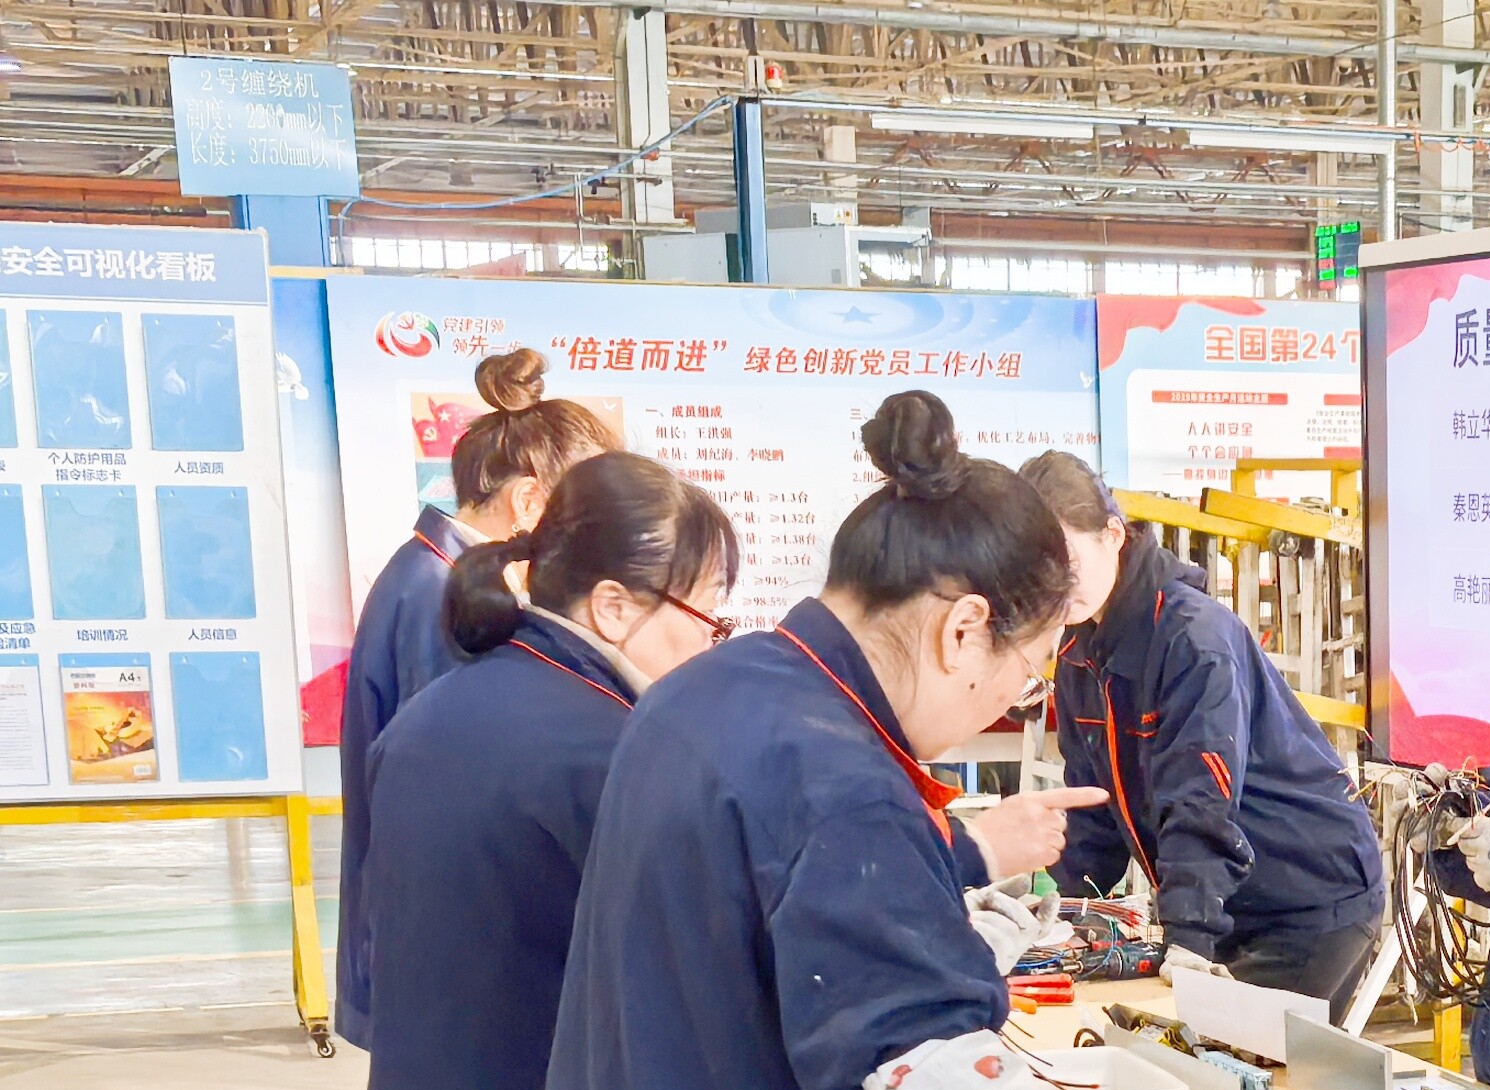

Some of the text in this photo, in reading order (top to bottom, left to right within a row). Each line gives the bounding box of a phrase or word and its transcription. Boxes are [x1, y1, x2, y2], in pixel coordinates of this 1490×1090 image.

[200, 67, 319, 98] 2号缠绕机
[1, 246, 216, 282] 安全可视化看板
[443, 316, 505, 335] 党建引领
[1205, 325, 1361, 364] 全国第24个
[550, 336, 1023, 379] “倍道而进” 绿色创新党员工作小组
[48, 452, 127, 466] 个人防护用品
[174, 461, 224, 475] 人员资质
[77, 628, 129, 642] 培训情况
[188, 627, 237, 642] 人员信息
[119, 672, 136, 683] A4
